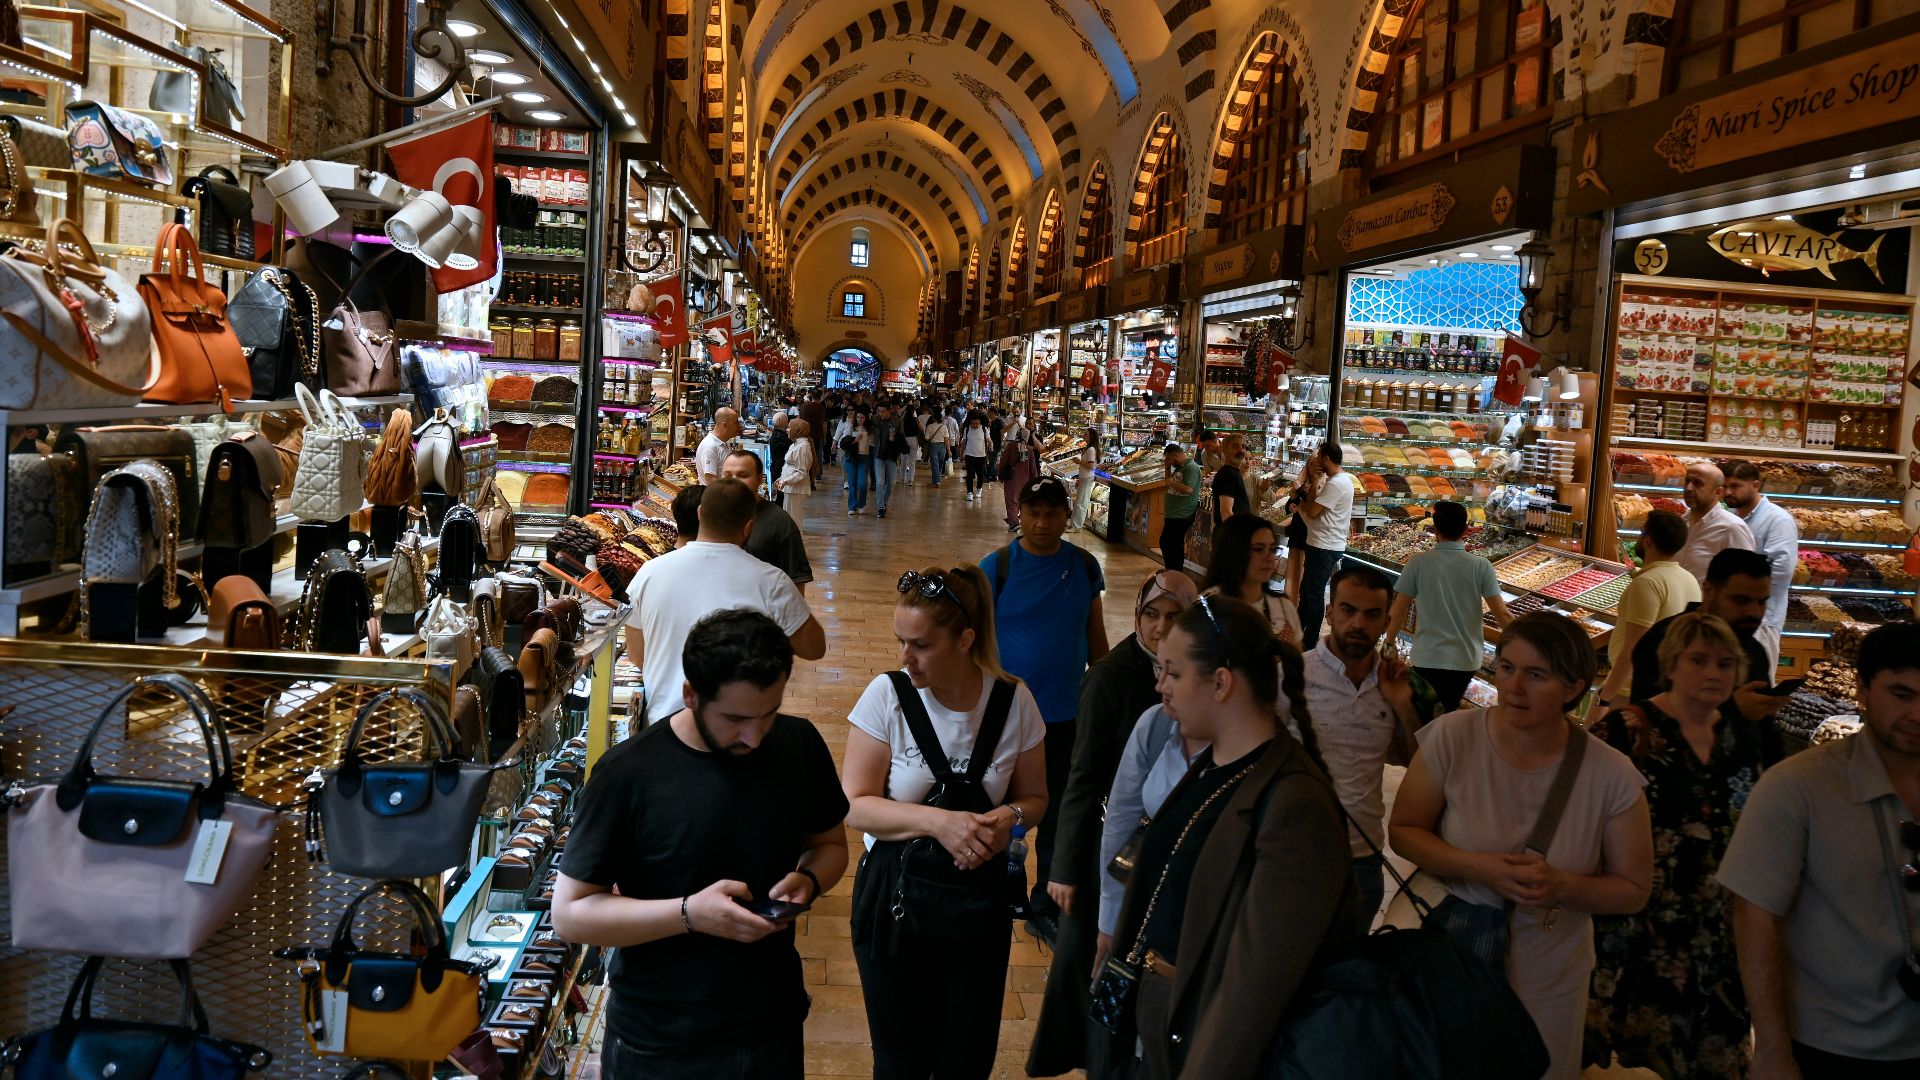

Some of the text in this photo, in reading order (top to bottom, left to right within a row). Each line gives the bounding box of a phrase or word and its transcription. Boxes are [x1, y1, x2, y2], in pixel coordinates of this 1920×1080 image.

[1702, 62, 1919, 142] Nuri Spice Shop
[1495, 196, 1508, 214] 53
[1354, 214, 1393, 235] Ramazan
[1719, 230, 1837, 262] CAVIAR
[1639, 247, 1664, 269] 55
